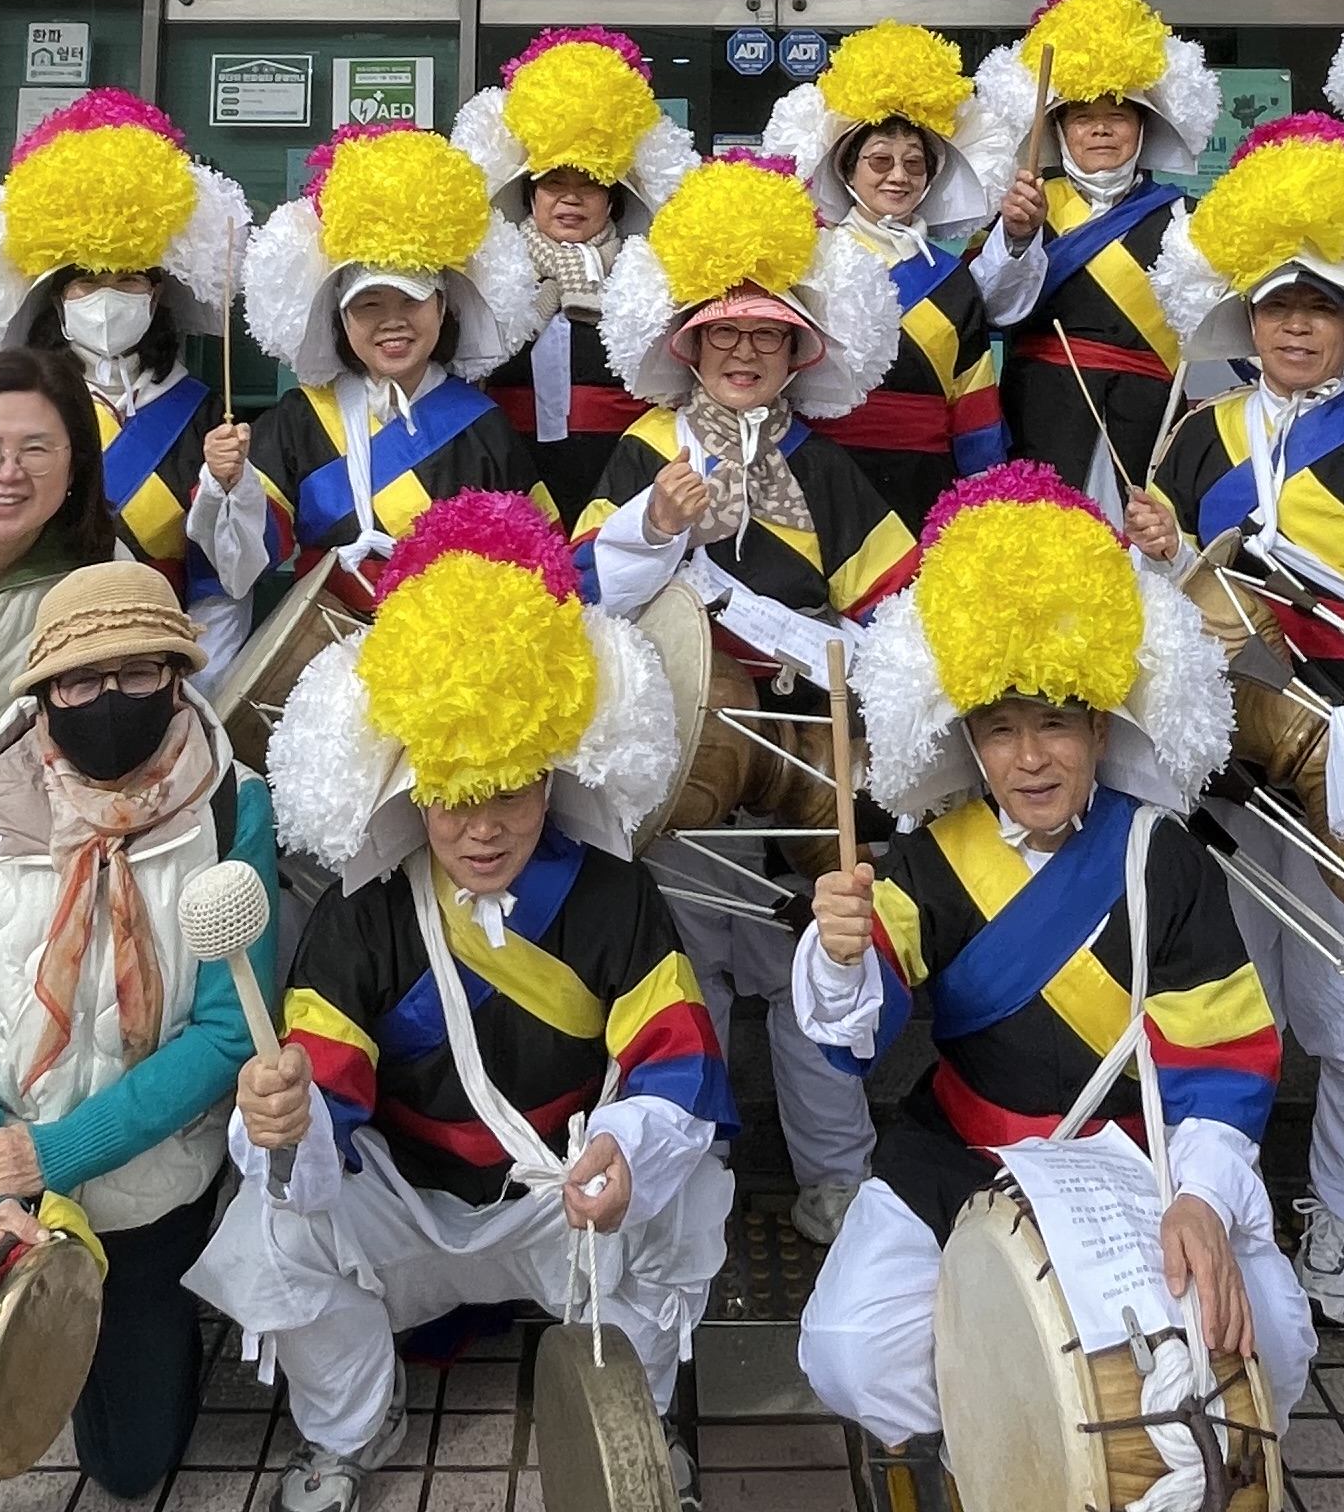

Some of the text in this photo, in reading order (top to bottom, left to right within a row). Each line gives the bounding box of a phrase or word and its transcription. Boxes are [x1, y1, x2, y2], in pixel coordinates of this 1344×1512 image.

[735, 42, 767, 59] ADT
[787, 43, 819, 60] ADT
[377, 103, 414, 119] AED
